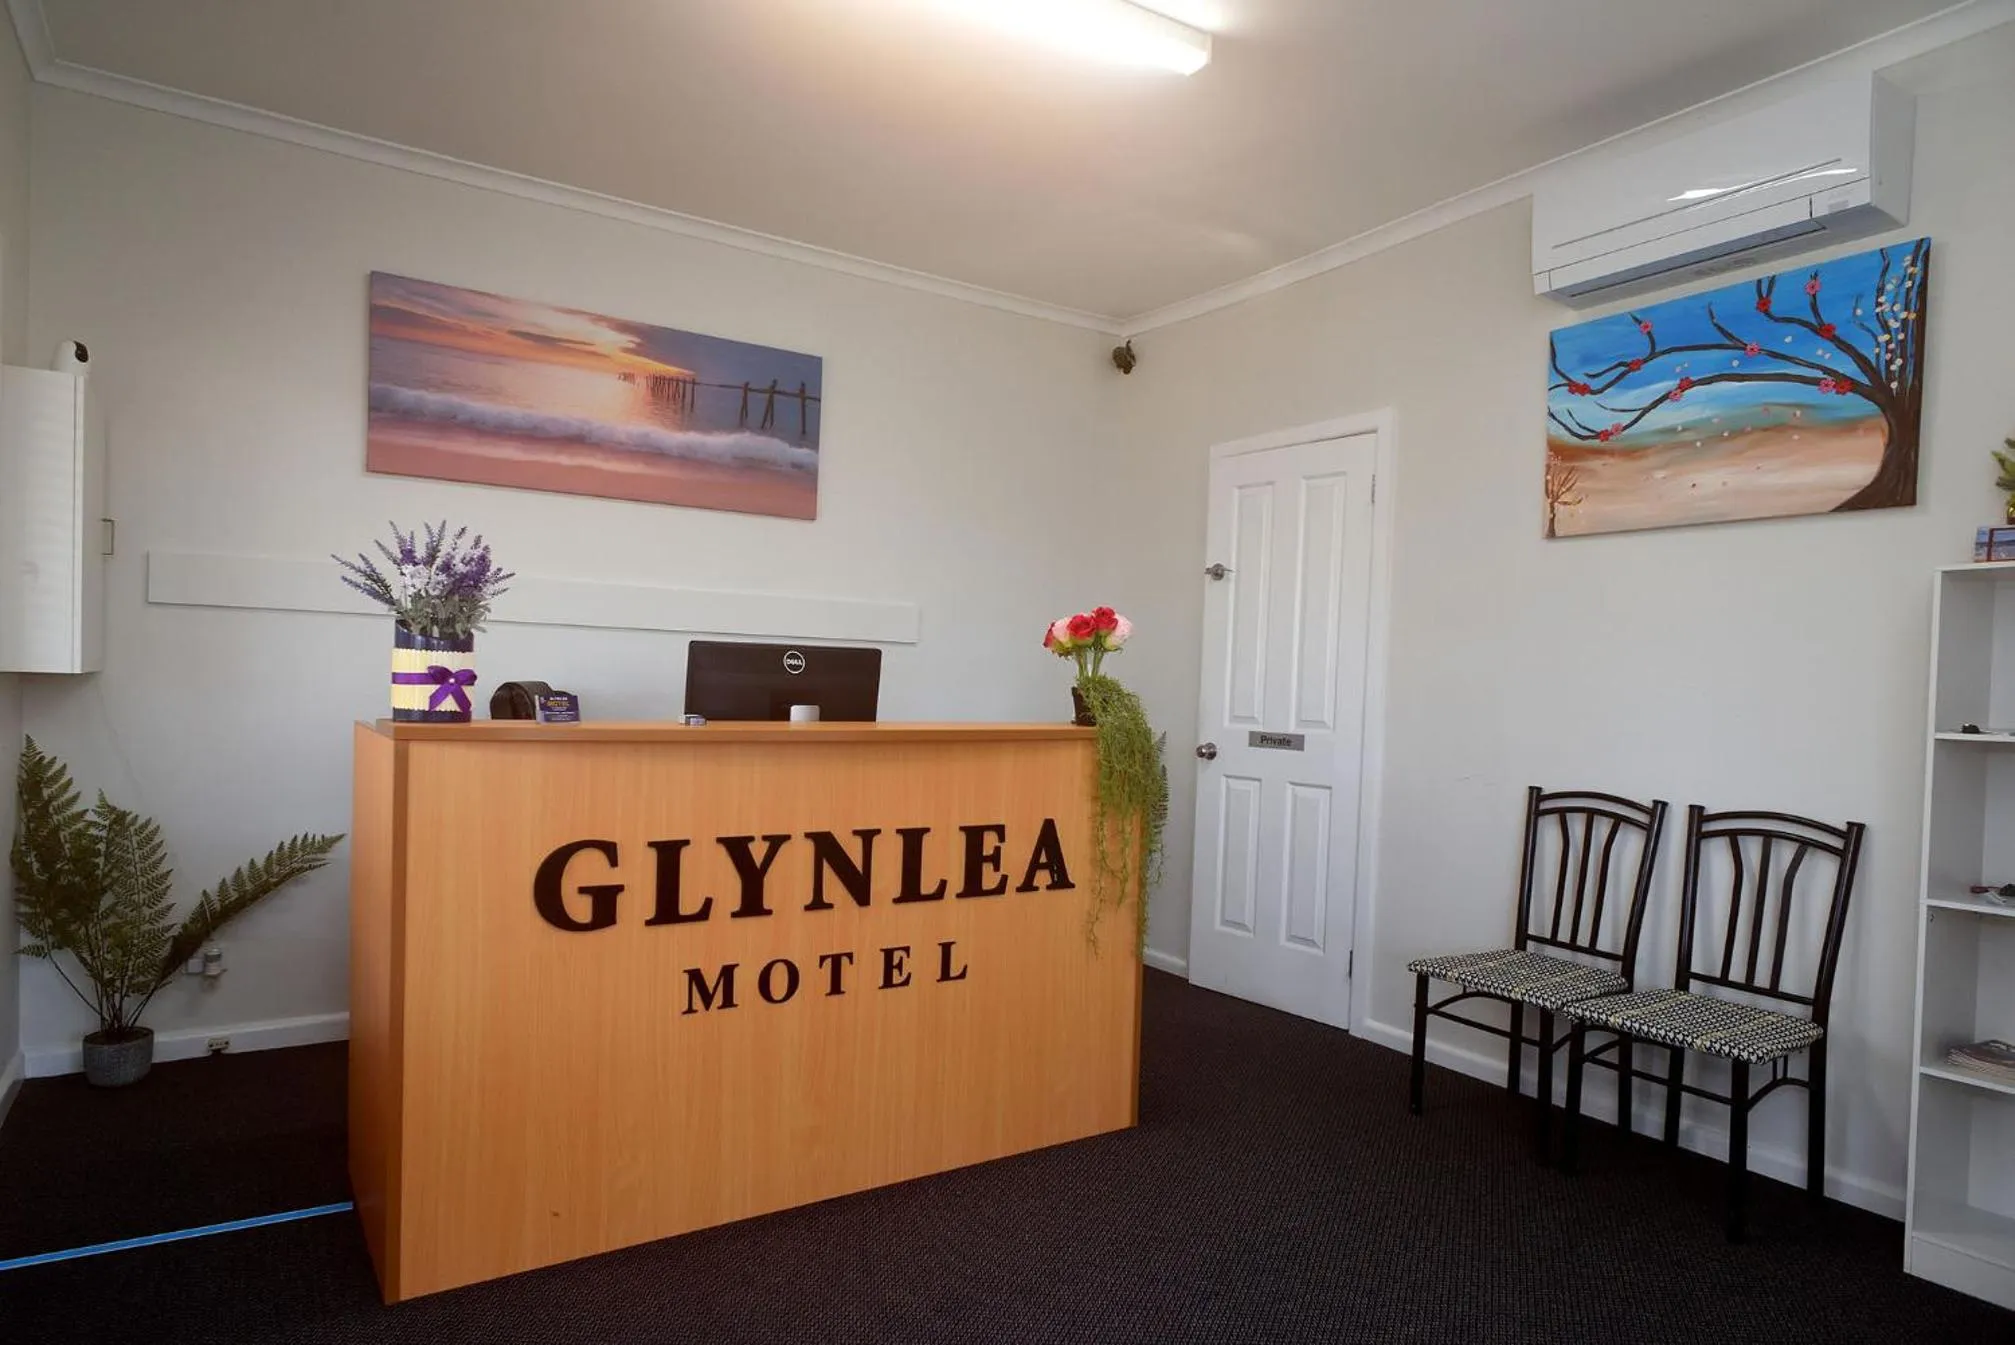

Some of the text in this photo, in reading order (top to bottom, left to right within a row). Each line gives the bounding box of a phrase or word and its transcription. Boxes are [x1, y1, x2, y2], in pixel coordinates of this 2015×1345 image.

[1260, 735, 1292, 747] Private
[534, 818, 1076, 933] GLYNLEA
[682, 942, 968, 1015] MOTEL
